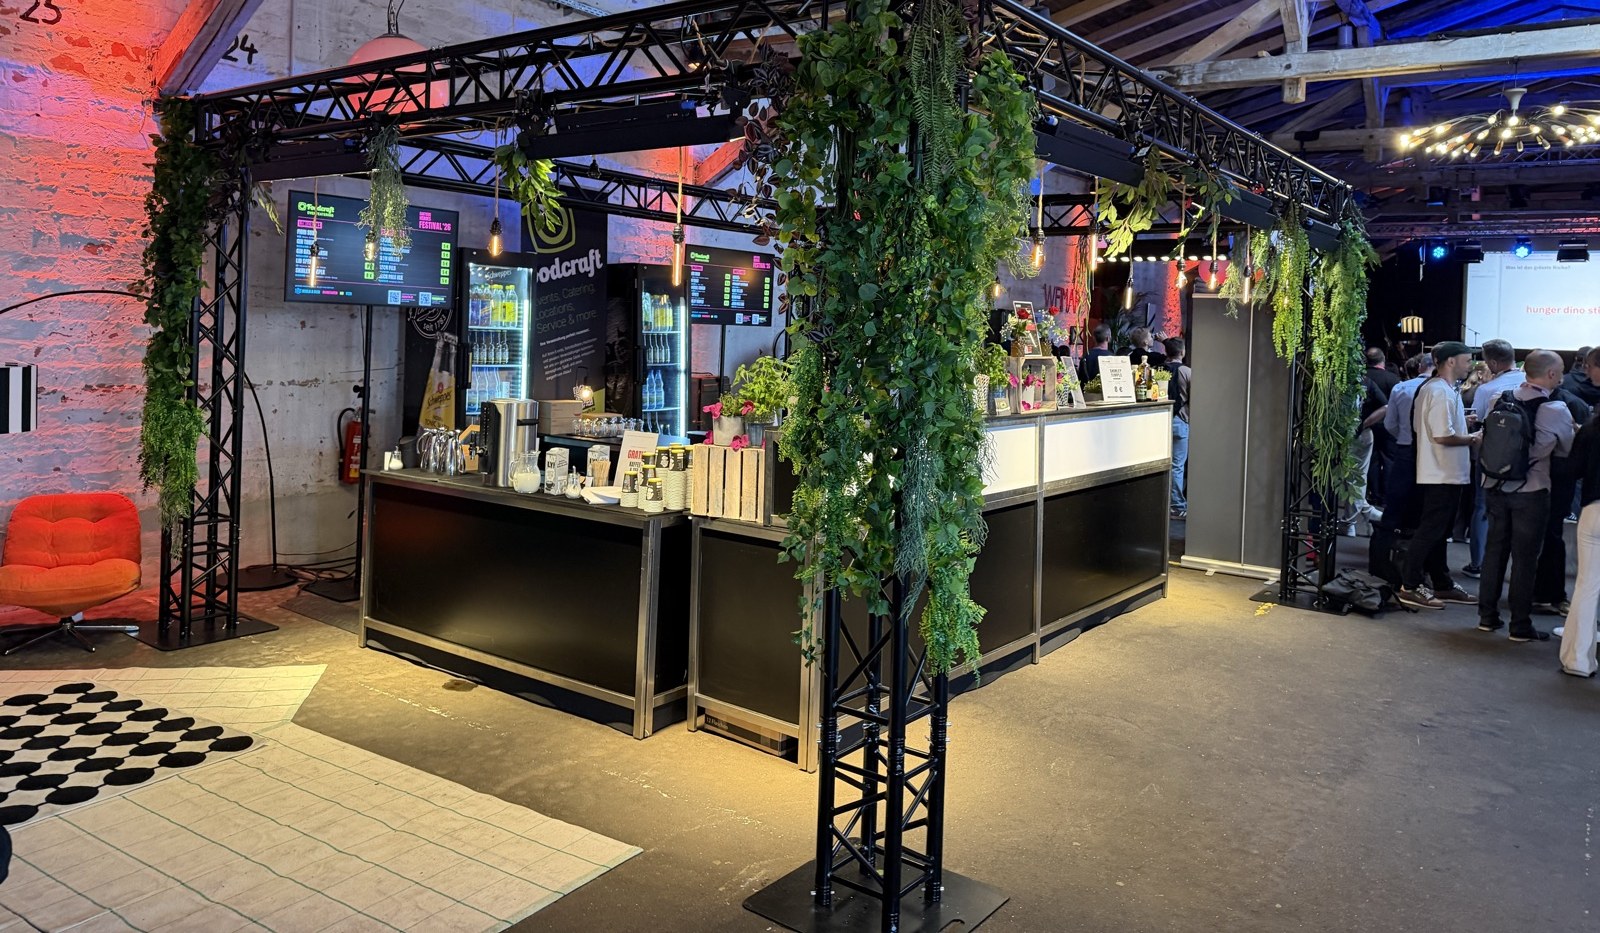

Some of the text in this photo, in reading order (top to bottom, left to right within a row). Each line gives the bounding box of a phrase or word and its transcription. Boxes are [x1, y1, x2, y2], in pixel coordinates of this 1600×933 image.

[418, 220, 442, 230] FESTIVAL
[1526, 305, 1562, 315] hunger
[1563, 306, 1586, 314] dino
